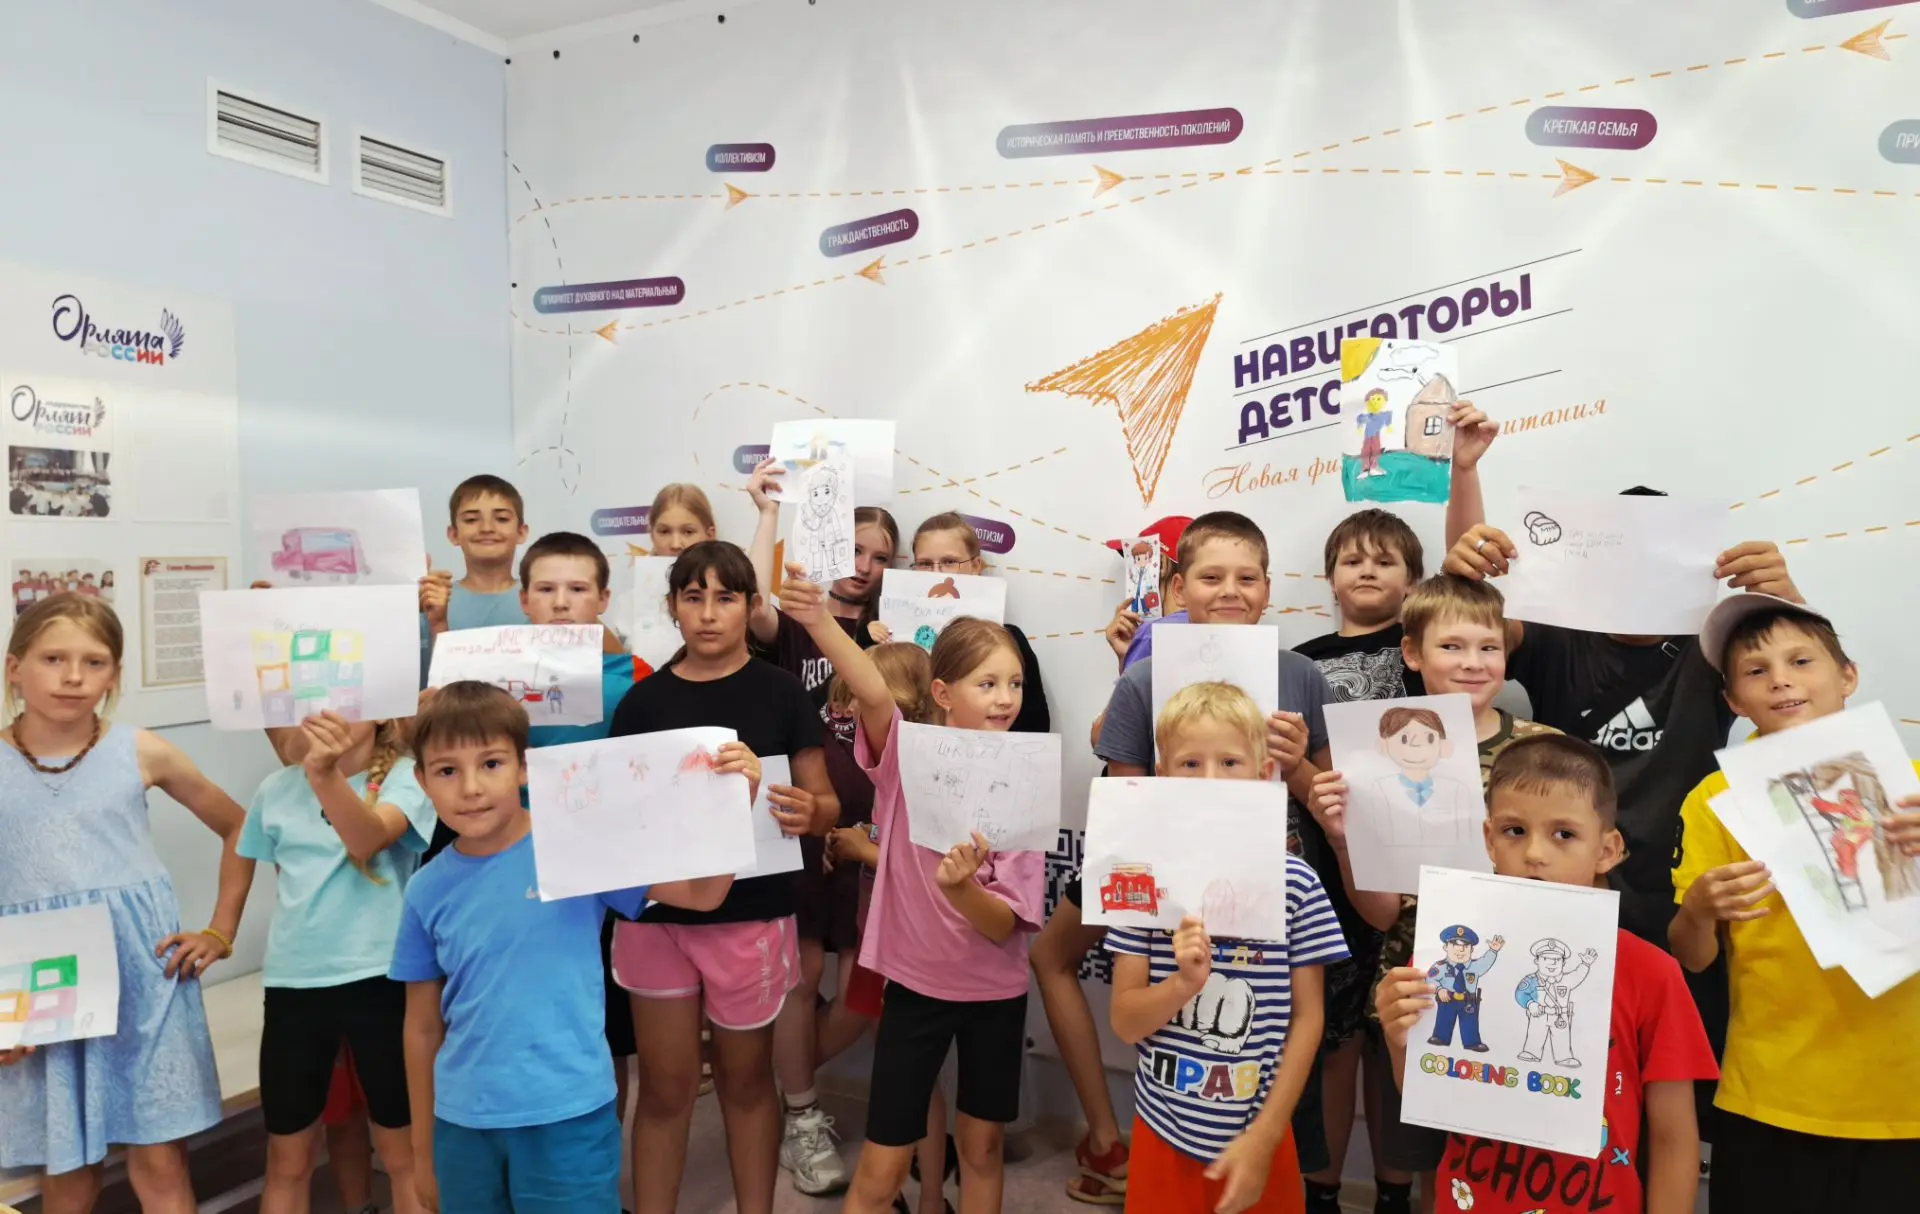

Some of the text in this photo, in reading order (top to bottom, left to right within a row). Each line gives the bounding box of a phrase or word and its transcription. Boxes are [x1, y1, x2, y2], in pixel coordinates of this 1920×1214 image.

[1006, 118, 1231, 149] ИСТОРИЧЕСКАЯ ПАМЯТЬ И ПРЕЕМСТВЕННОСТЬ ПОКОЛЕНИЙ
[1543, 119, 1639, 137] КРЕПКАЯ СЕМЬЯ
[715, 151, 766, 164] КОЛЛЕКТИВИЗМ
[827, 218, 909, 248] ГРАЖДАНСТВЕННОСТЬ
[611, 289, 625, 301] НАД
[625, 285, 677, 299] МАТЕРИАЛЬНЫМ
[52, 294, 165, 350] Орлята
[83, 343, 164, 366] РОССИИ
[1238, 379, 1341, 444] ДЕТС
[1202, 399, 1607, 499] Новая фи итания
[1151, 1050, 1262, 1101] ПРАВ
[1420, 1053, 1581, 1100] COLORING BOOK
